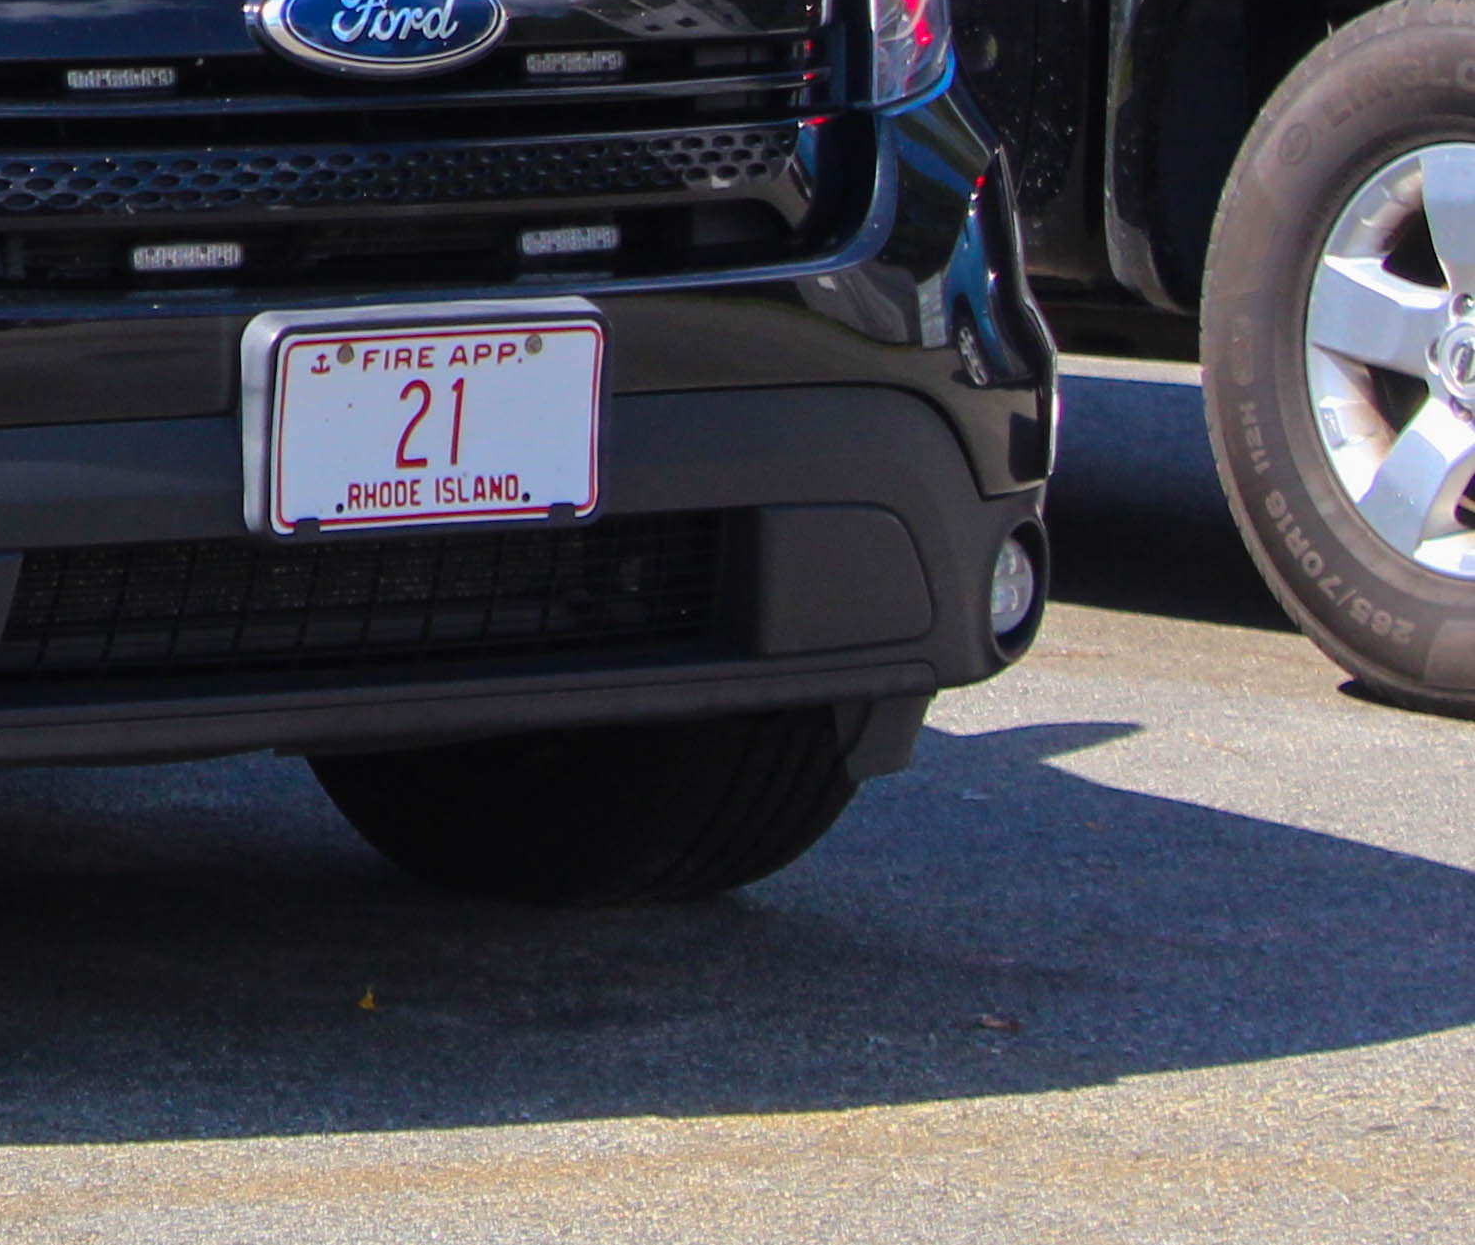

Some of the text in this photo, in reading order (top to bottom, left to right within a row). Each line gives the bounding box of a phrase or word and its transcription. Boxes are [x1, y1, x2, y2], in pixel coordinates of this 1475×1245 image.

[362, 342, 523, 372] FIRE APP.
[395, 377, 465, 470] 21
[347, 474, 520, 510] RHODE ISLAND
